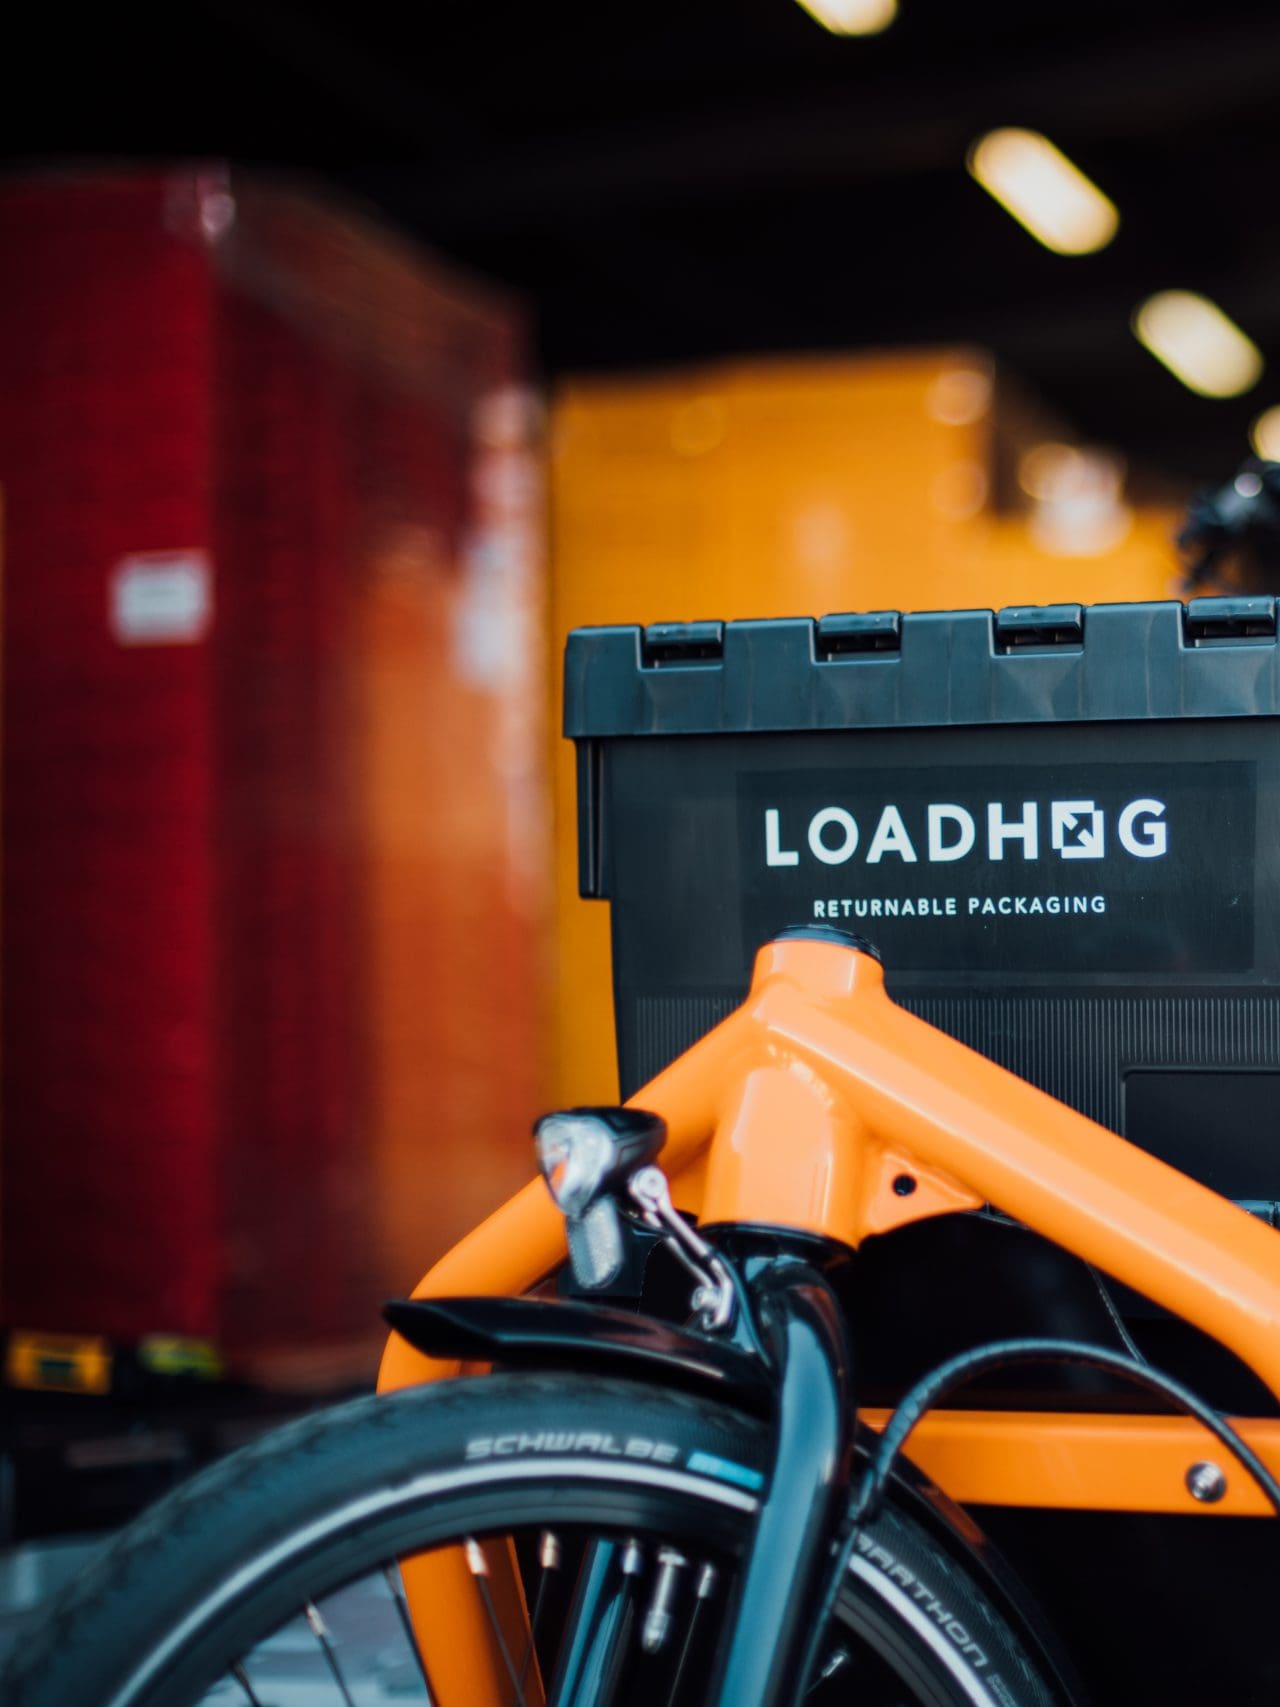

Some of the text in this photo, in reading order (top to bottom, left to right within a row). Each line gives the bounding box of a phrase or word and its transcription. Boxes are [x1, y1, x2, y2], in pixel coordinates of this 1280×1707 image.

[813, 895, 1106, 918] RETURNABLE PACKAGING
[465, 1432, 679, 1464] SCHWALBE
[857, 1531, 989, 1667] ARATHON
